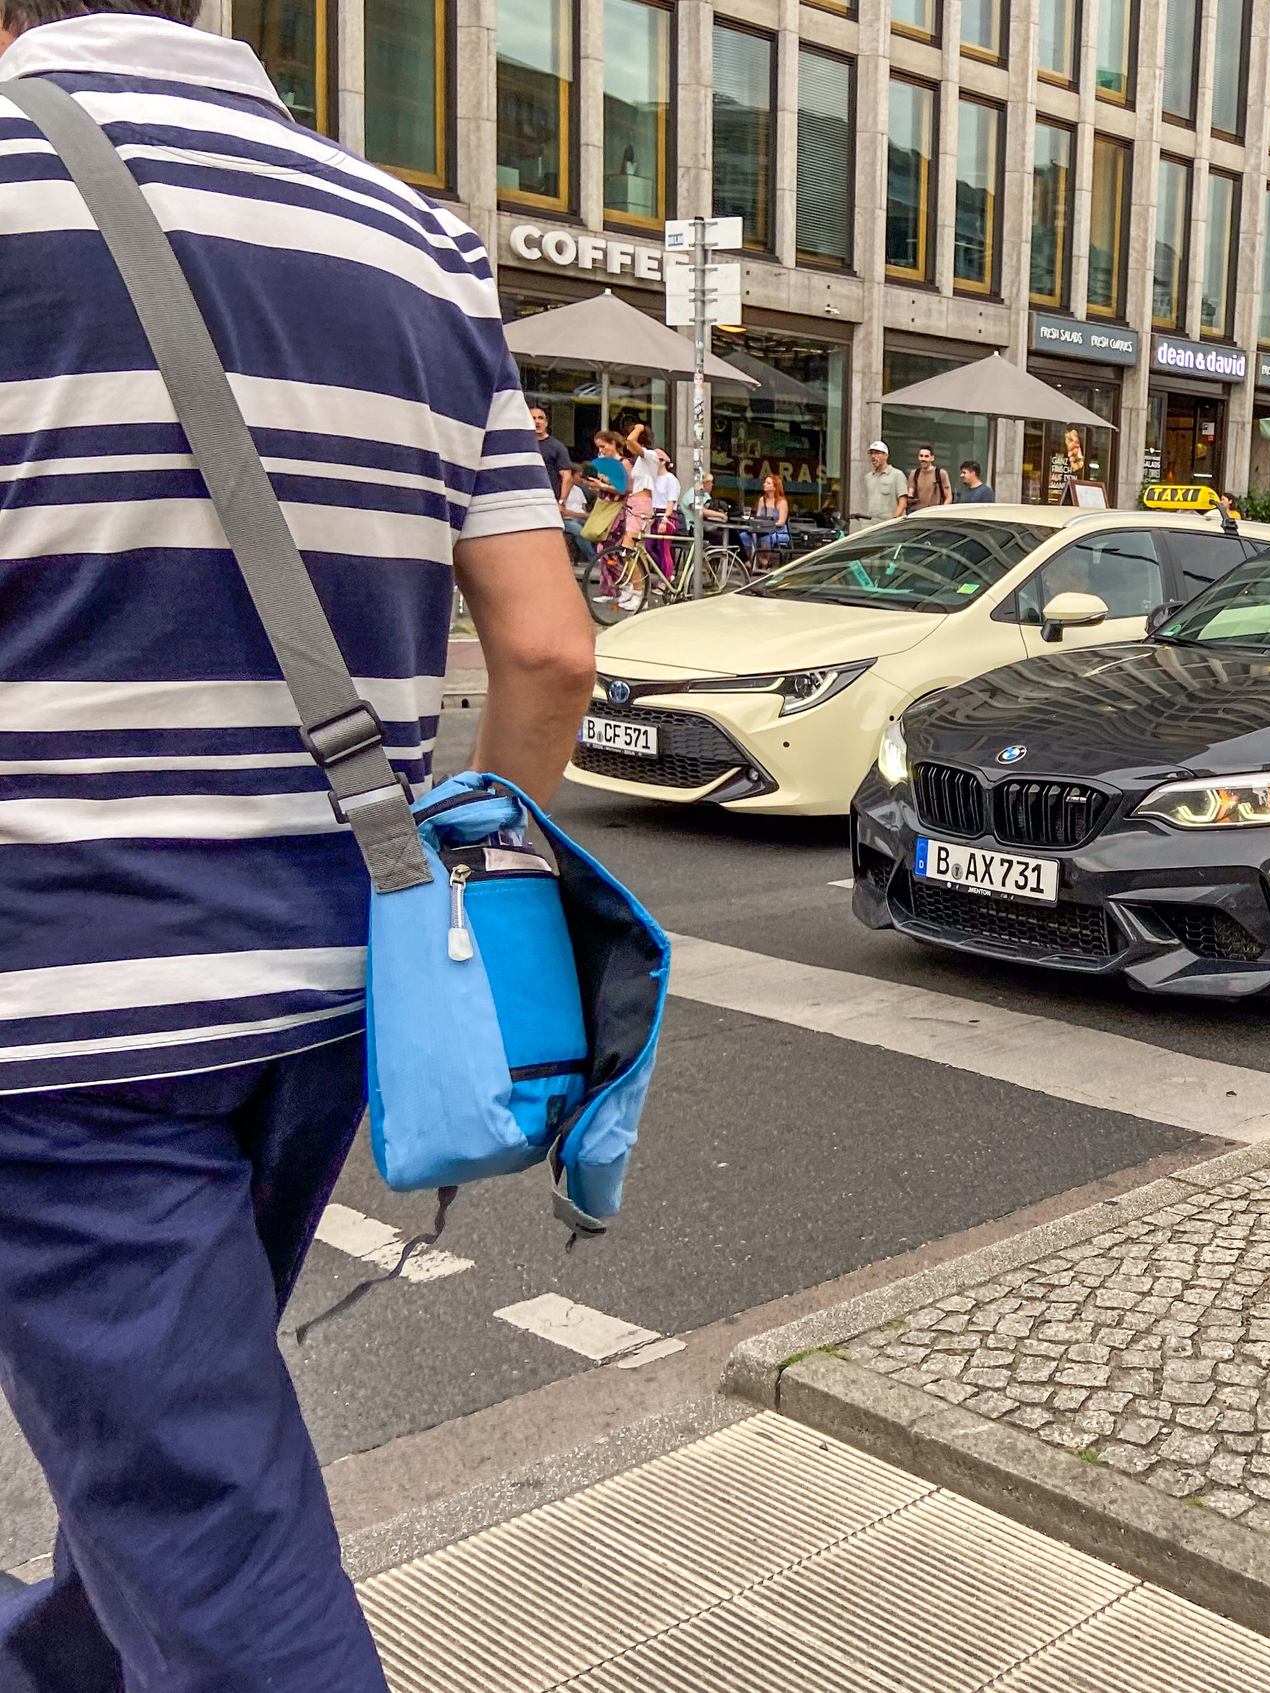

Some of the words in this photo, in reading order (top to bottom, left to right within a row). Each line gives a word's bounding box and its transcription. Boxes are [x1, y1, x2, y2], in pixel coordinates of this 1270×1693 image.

[1040, 326, 1059, 340] FRESH
[1060, 329, 1083, 344] SALADS
[1091, 335, 1109, 348] FRESH
[1157, 342, 1194, 369] dean
[1195, 352, 1206, 370] &
[1206, 350, 1246, 377] david
[1153, 488, 1194, 502] TAXI
[587, 719, 596, 739] B
[937, 846, 950, 875] B
